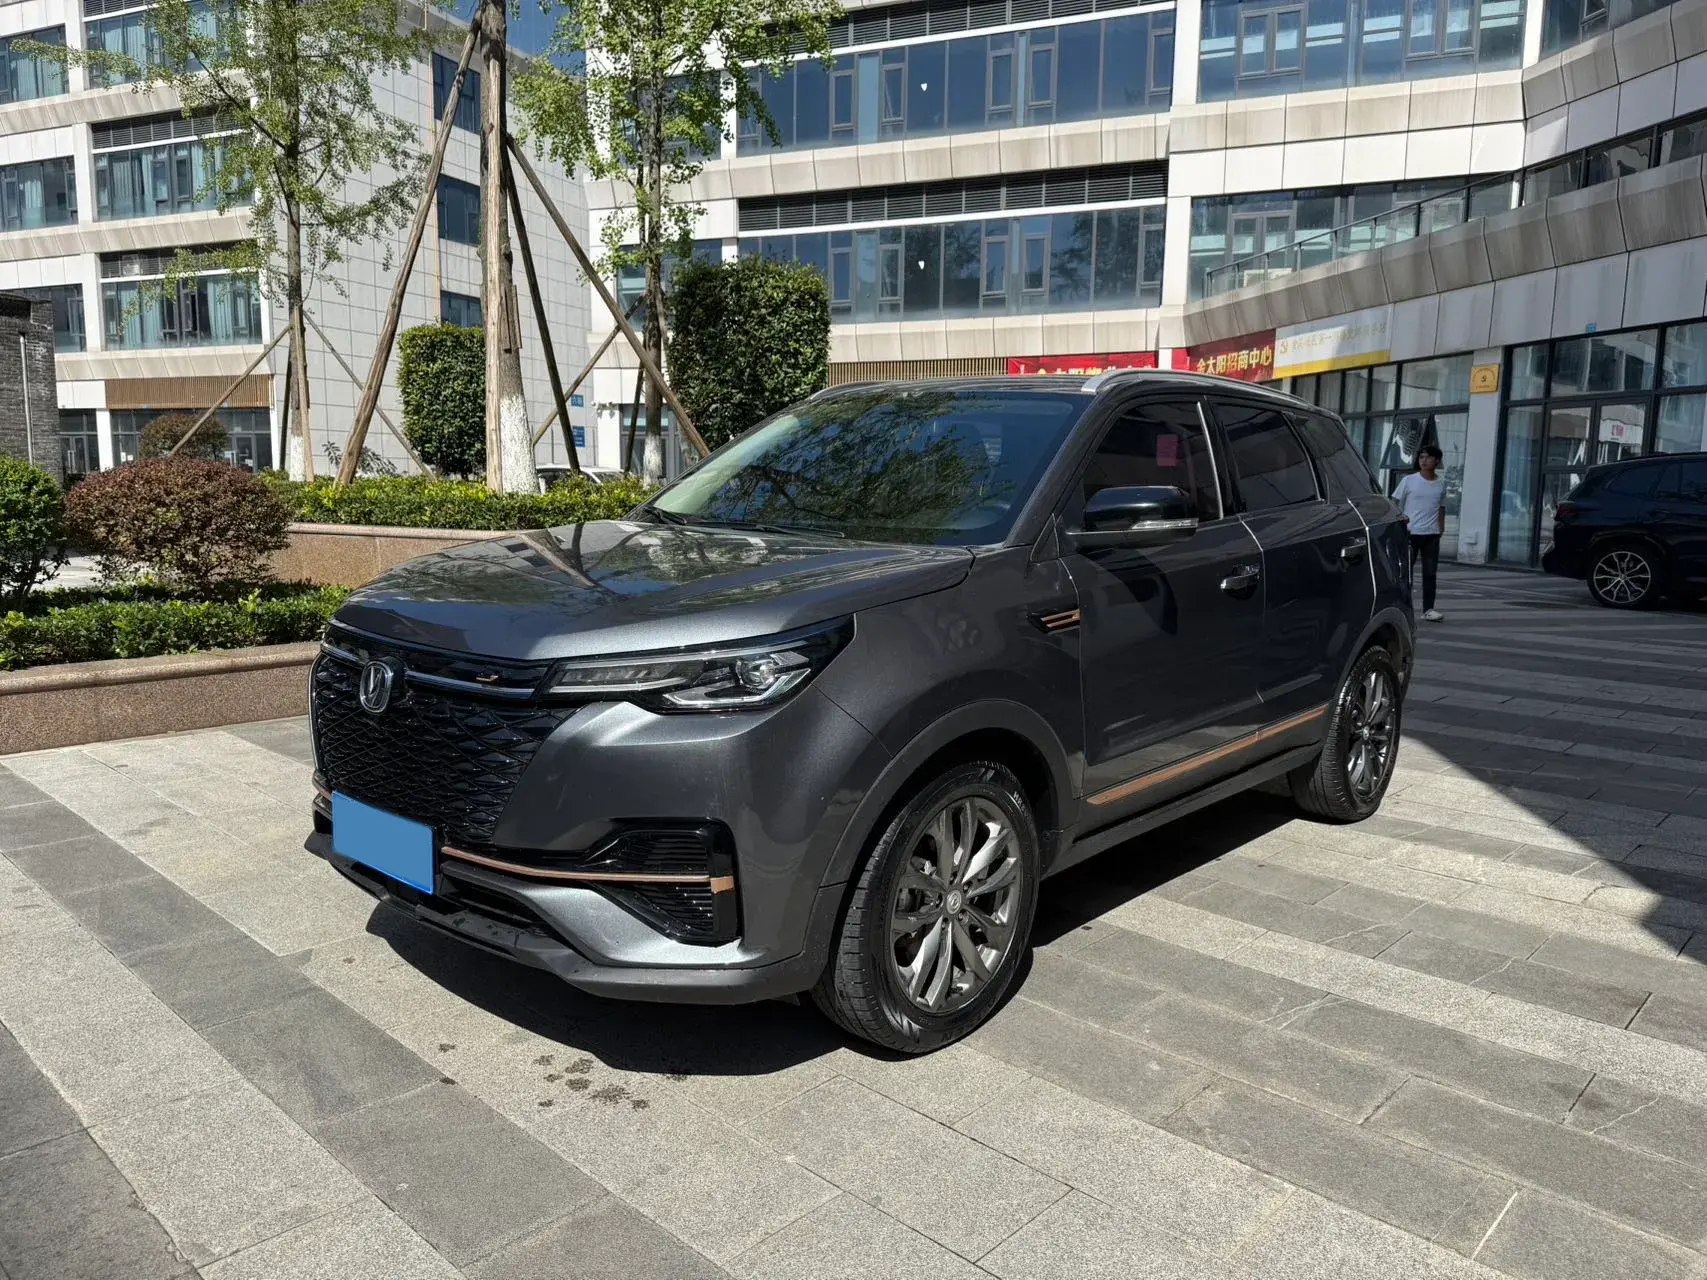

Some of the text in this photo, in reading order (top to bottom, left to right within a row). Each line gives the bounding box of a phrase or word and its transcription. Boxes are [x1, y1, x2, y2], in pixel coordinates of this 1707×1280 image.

[1196, 345, 1272, 374] 金太阳招商中心
